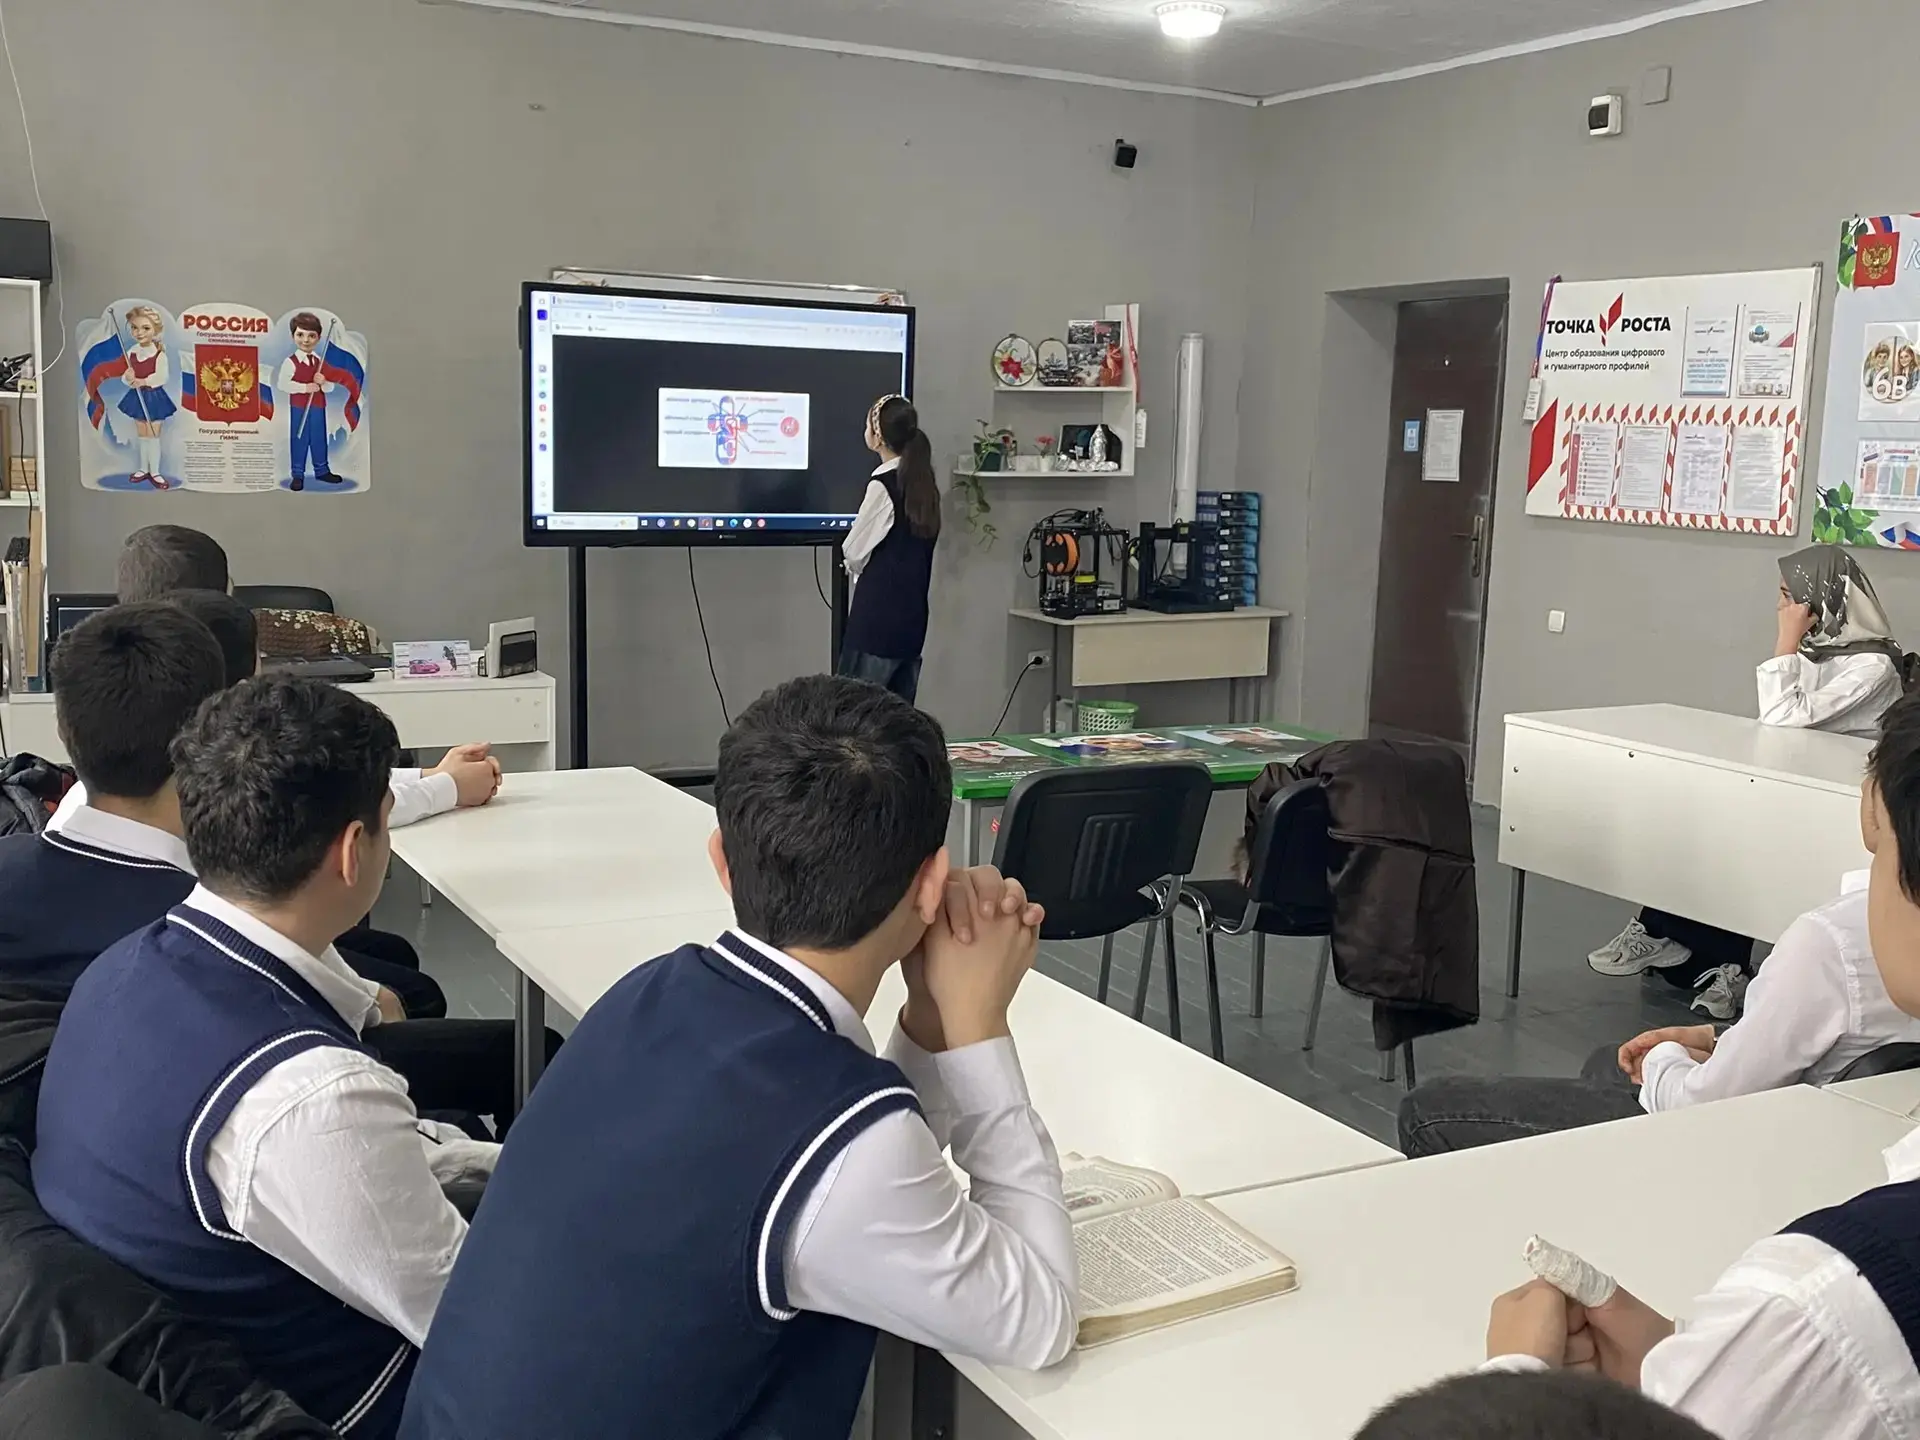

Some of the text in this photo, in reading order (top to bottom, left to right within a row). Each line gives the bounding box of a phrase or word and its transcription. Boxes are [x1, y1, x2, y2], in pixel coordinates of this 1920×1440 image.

[183, 314, 268, 333] РОССИЯ
[1546, 316, 1671, 334] ТОЧКА РОСТА
[1545, 348, 1665, 358] Центр образования цифрового
[1550, 362, 1607, 372] гуманитарного
[1608, 361, 1649, 371] профилей
